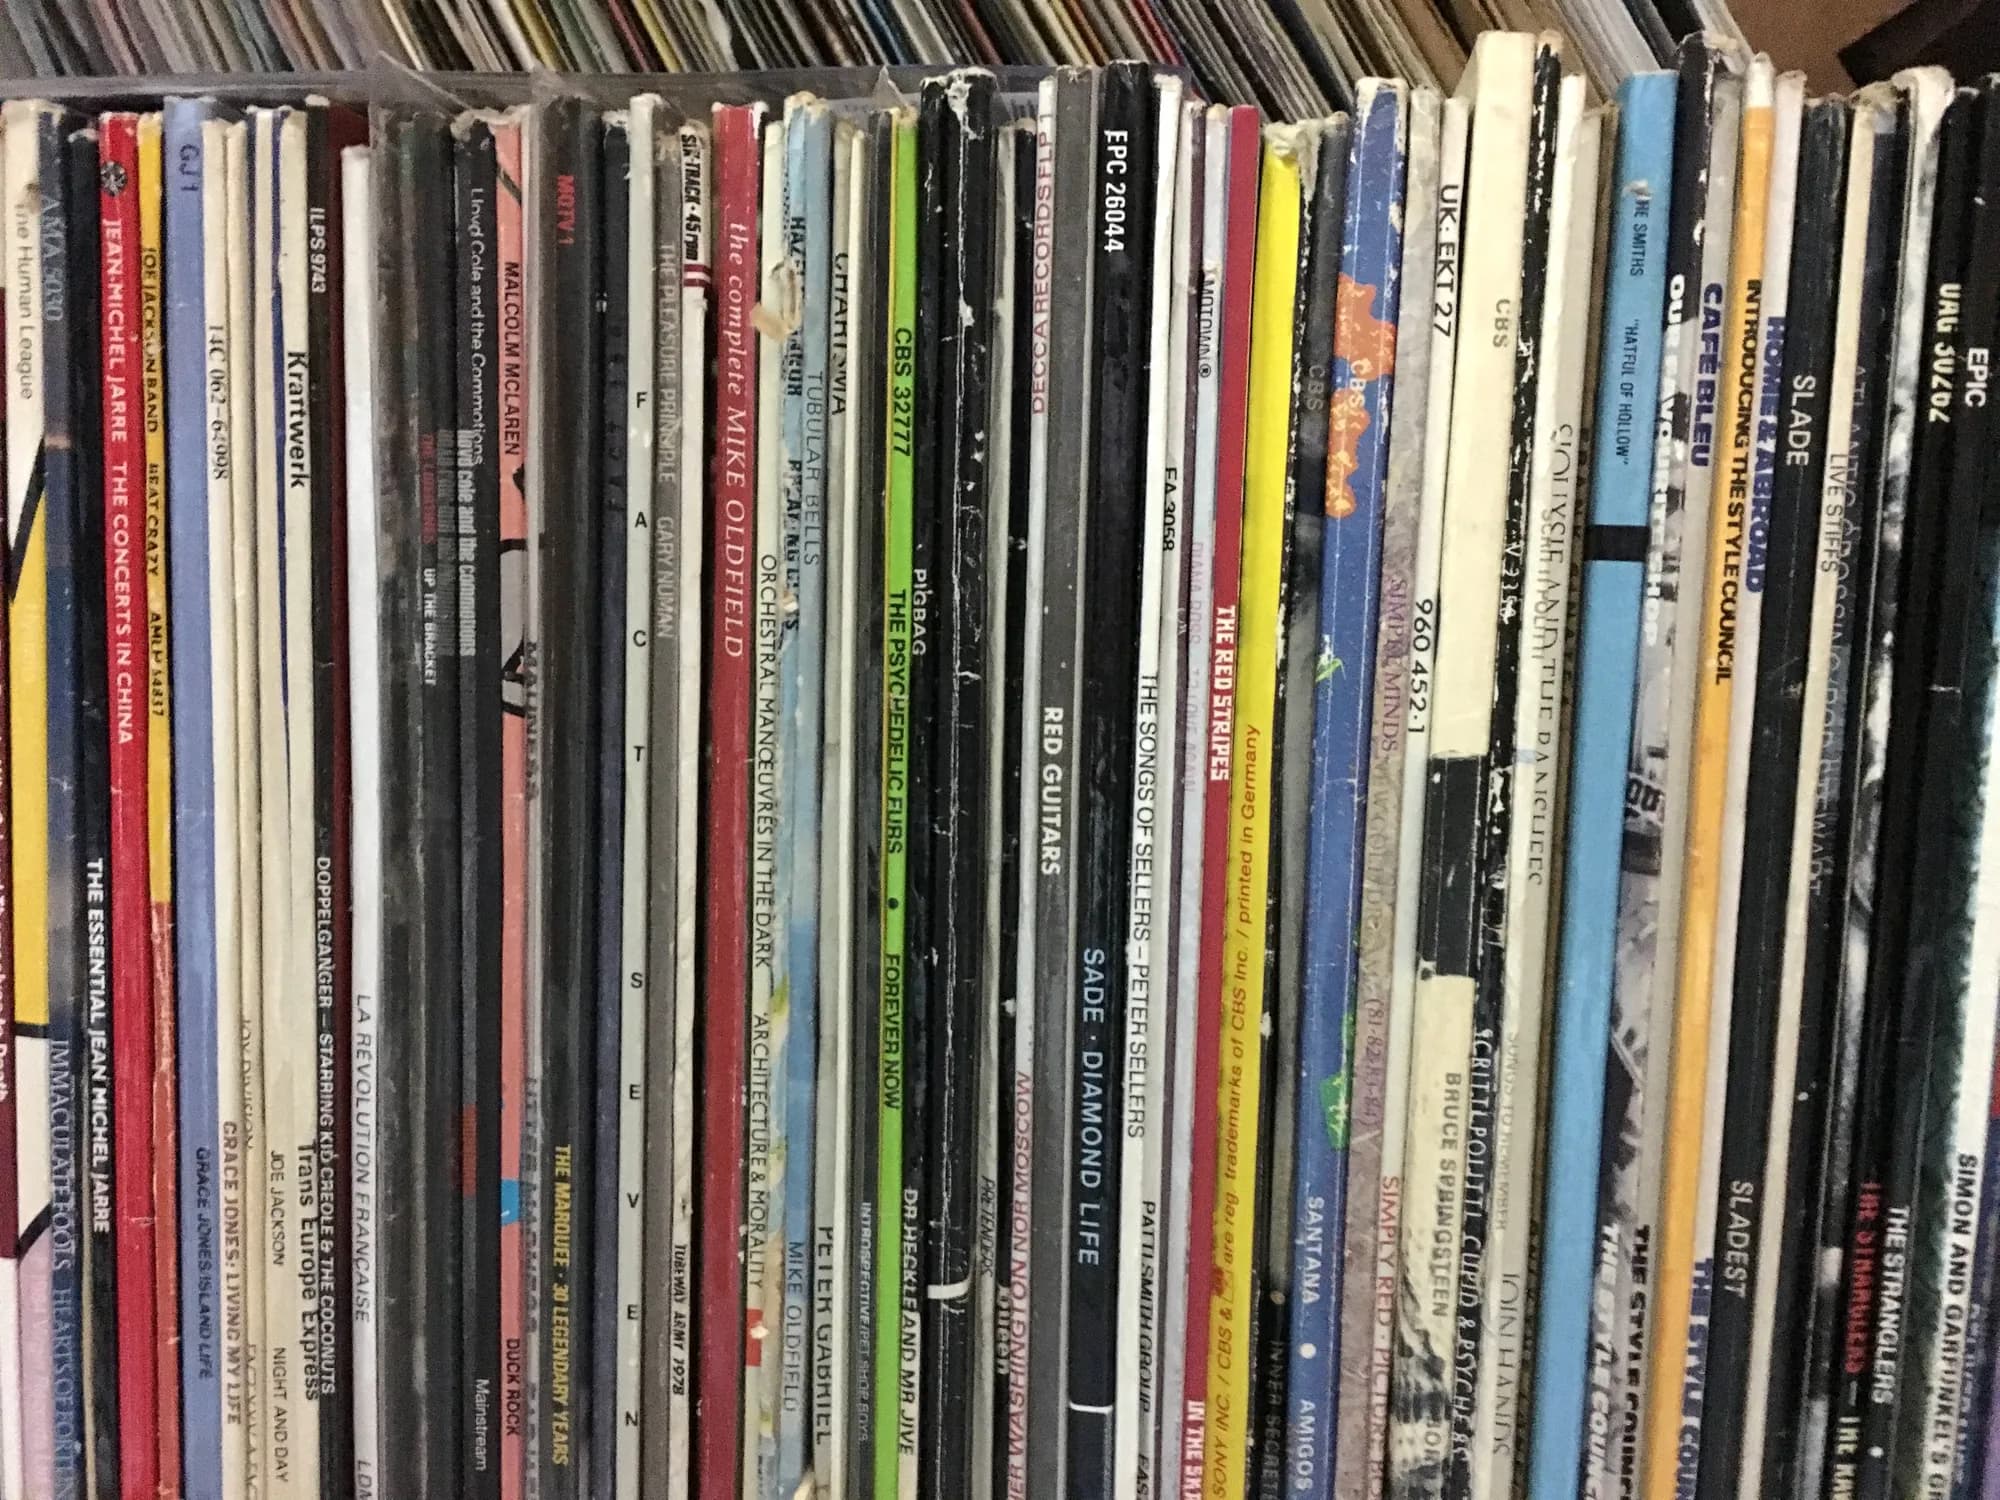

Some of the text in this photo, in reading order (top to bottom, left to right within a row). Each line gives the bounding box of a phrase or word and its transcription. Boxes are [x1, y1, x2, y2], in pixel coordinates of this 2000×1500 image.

[310, 207, 327, 293] ILPS 9743
[1104, 129, 1128, 253] EPC 26044
[17, 246, 35, 399] Human League
[1432, 183, 1460, 337] UK: EKT 27
[1493, 299, 1511, 348] CBS
[143, 247, 159, 433] JOE JACKSON BAND
[467, 188, 487, 465] Lloyd Cole and the Commotions
[503, 261, 521, 457] MALCOLM MCLAREN
[1305, 364, 1325, 411] CBS
[1349, 358, 1367, 409] CBS
[1964, 347, 1990, 408] EPIC
[287, 350, 310, 489] Kraftwerk
[722, 222, 749, 658] the complete MIKE OLDFIELD
[892, 327, 912, 456] CBS 32777
[1690, 379, 1717, 467] BLEU
[1785, 375, 1816, 467] SLADE
[102, 219, 133, 745] JEAN-MICHEL JARRE THE CONCERTS IN CHINA
[147, 463, 159, 577] BEAT CRAZY
[803, 370, 824, 566] TUBULAR BELLS
[1715, 278, 1763, 686] INTRODUCING THE STYLE COUNCIL
[1820, 453, 1849, 574] LIVE STIFFS
[422, 568, 437, 687] UP THE BRACKET
[657, 516, 676, 638] GARY NUMAN
[759, 553, 777, 690] ORCHESTRAL
[912, 568, 927, 656] PIGBAG
[886, 588, 906, 854] THE PSYCHEDELIC FURS
[1210, 604, 1236, 781] THE RED STRIPES
[756, 841, 773, 862] IN
[1040, 707, 1064, 876] RED GUITARS
[755, 867, 773, 906] THE
[755, 912, 772, 969] DARK
[1128, 673, 1158, 1139] THE SONGS OF SELLERS PETER SELLERS
[87, 858, 111, 1233] THE ESSENTIAL JEAN MICHEL JARRE
[883, 953, 901, 1111] FOREVER NOW
[1471, 1027, 1495, 1119] SCRITTI
[315, 856, 336, 1395] DOPPELGANGER STARRING KID CREOLE & THE COCONUTS
[1078, 947, 1104, 1266] SADE DIAMOND LIFE
[270, 1150, 285, 1267] JOE JACKSON
[979, 1174, 996, 1278] PRETENDERS
[1140, 1200, 1157, 1260] PATTI
[1430, 1071, 1463, 1317] BRUCE SPRINGSTEEN
[1466, 1126, 1490, 1217] POLITTI
[1952, 1153, 1980, 1236] SIMON
[223, 1121, 241, 1425] GRACE JONES: LIVING MY LIFE
[297, 1140, 320, 1401] Trans Europe Express
[1006, 1072, 1032, 1457] WASHINGTON NOR MOSCOW
[1139, 1265, 1155, 1331] SMITH
[1459, 1234, 1482, 1308] CUPID
[1722, 1180, 1756, 1299] SLADEST
[1947, 1242, 1971, 1297] AND
[551, 1143, 571, 1467] THE MARQUEE 30 LEGENDARY YEARS
[672, 1310, 687, 1351] ARMY
[783, 1239, 804, 1412] MIKE OLDFIELD
[815, 1226, 834, 1446] PETER GABRIEL
[899, 1188, 919, 1456] DR HECKLE AND MR JIVE
[1294, 1195, 1325, 1492] SANTANA AMIGOS
[1461, 1315, 1476, 1329] &
[1594, 1221, 1620, 1388] THE STYLE
[1870, 1204, 1912, 1405] THE STRANGLERS
[272, 1346, 289, 1483] NIGHT AND DAY
[474, 1379, 491, 1471] Mainstream
[505, 1338, 521, 1437] DUCK ROCK
[671, 1357, 687, 1396] 1978
[1453, 1338, 1477, 1423] PSYCHE
[1930, 1303, 1965, 1465] GARFUNKEL'S
